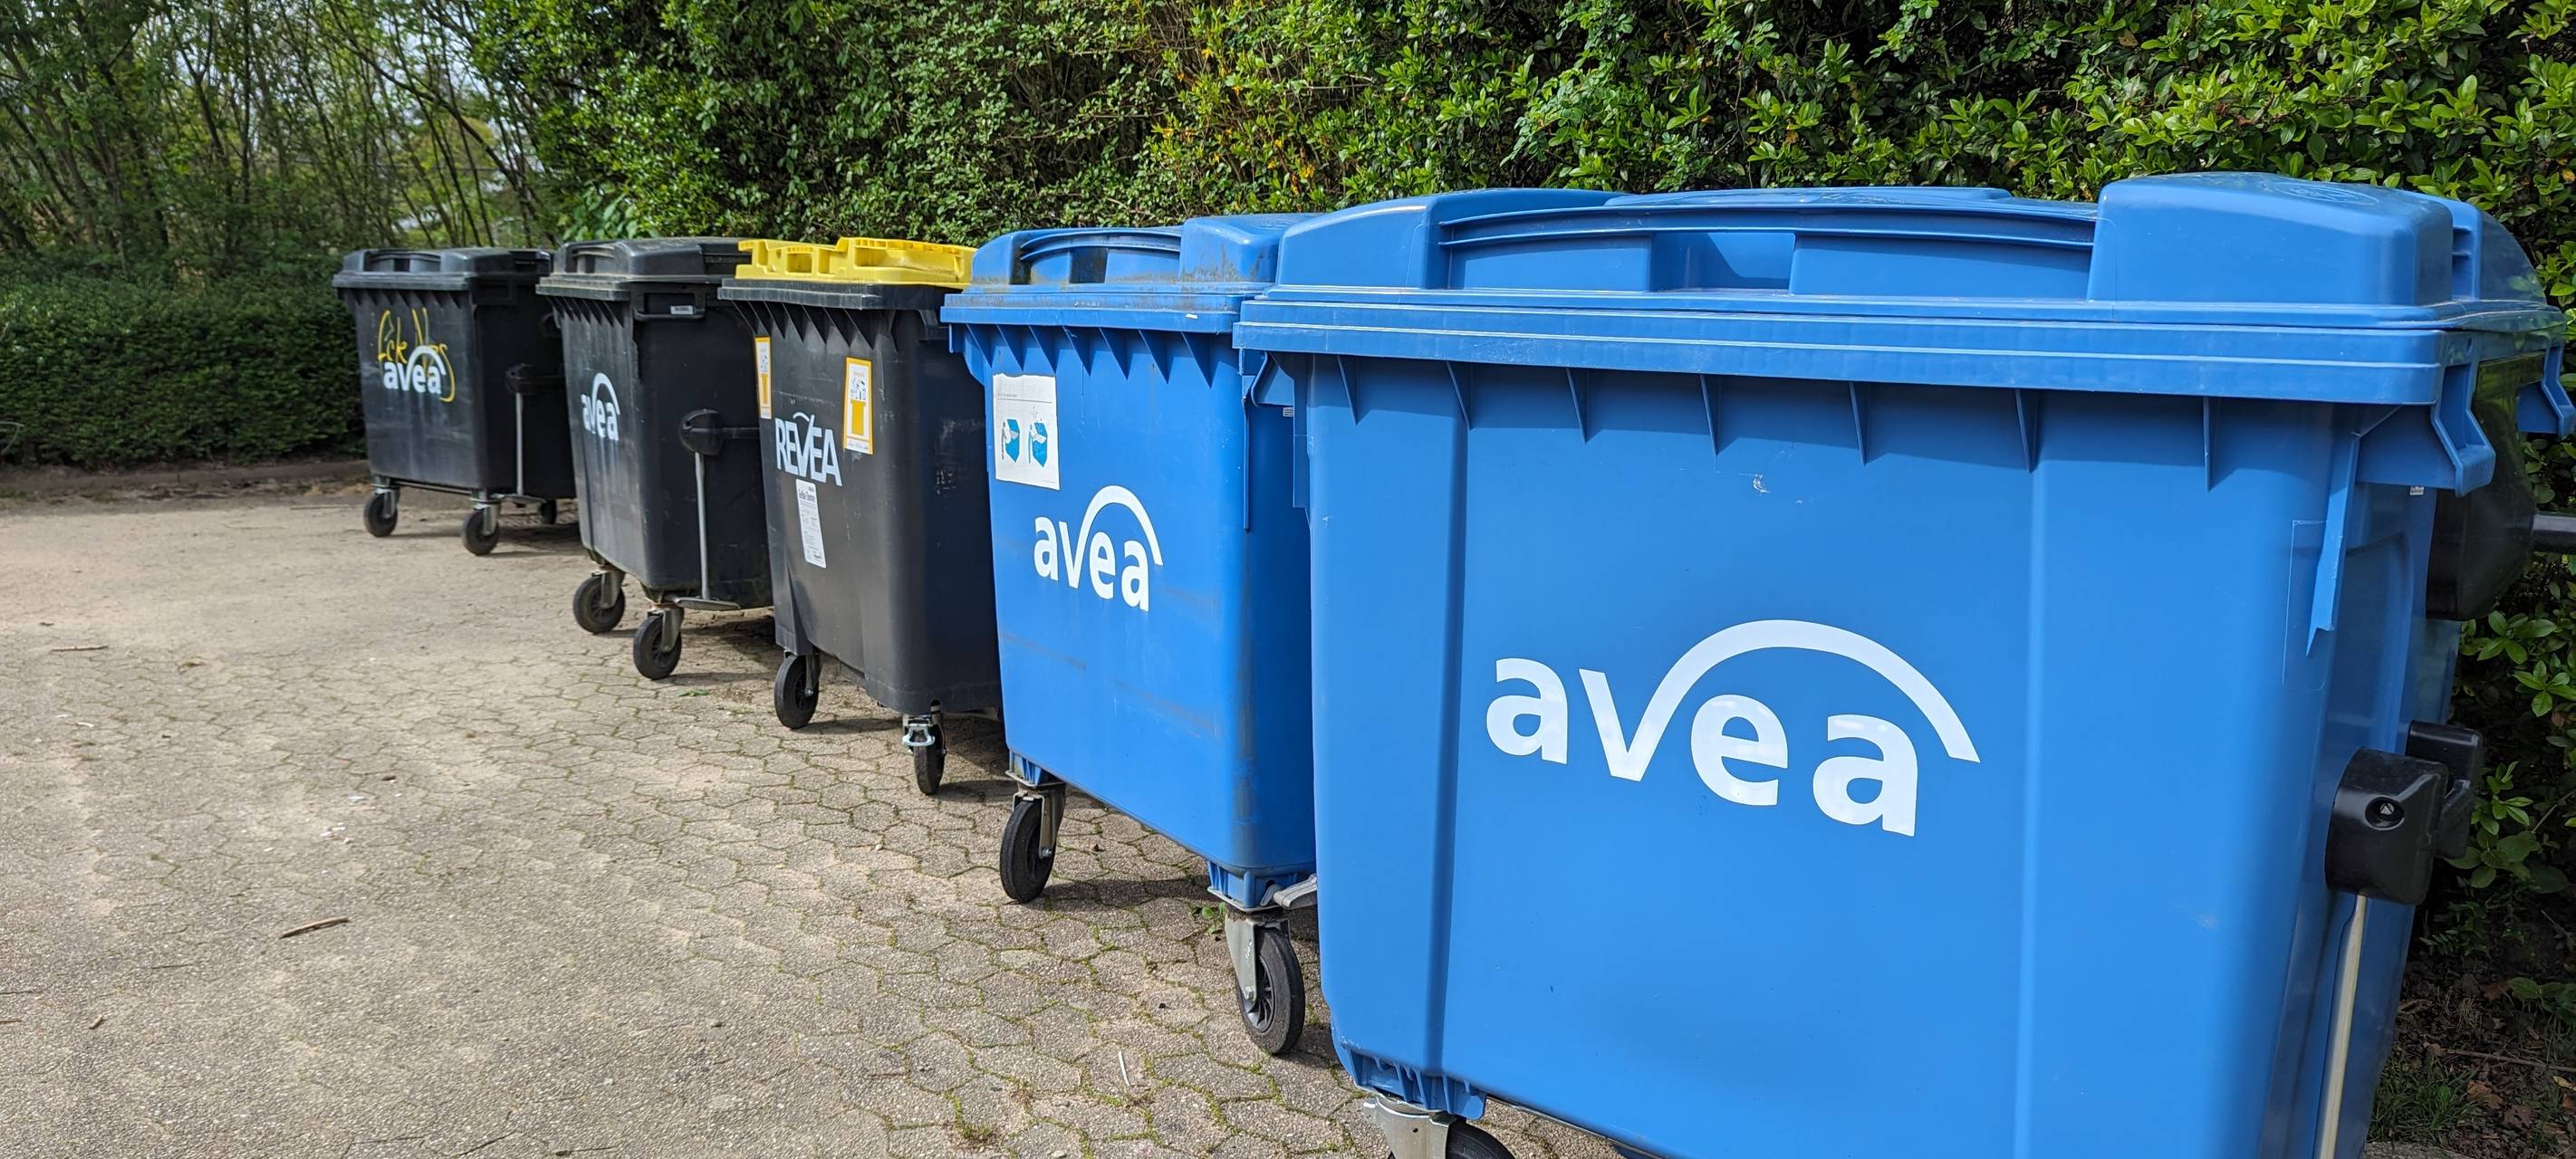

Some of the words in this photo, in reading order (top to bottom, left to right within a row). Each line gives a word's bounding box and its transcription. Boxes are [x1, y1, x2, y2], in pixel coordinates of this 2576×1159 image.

[383, 345, 447, 395] avea
[581, 372, 621, 442] avea
[774, 411, 843, 486] REVEA
[1033, 485, 1163, 612] avea
[1485, 619, 1981, 838] avea
